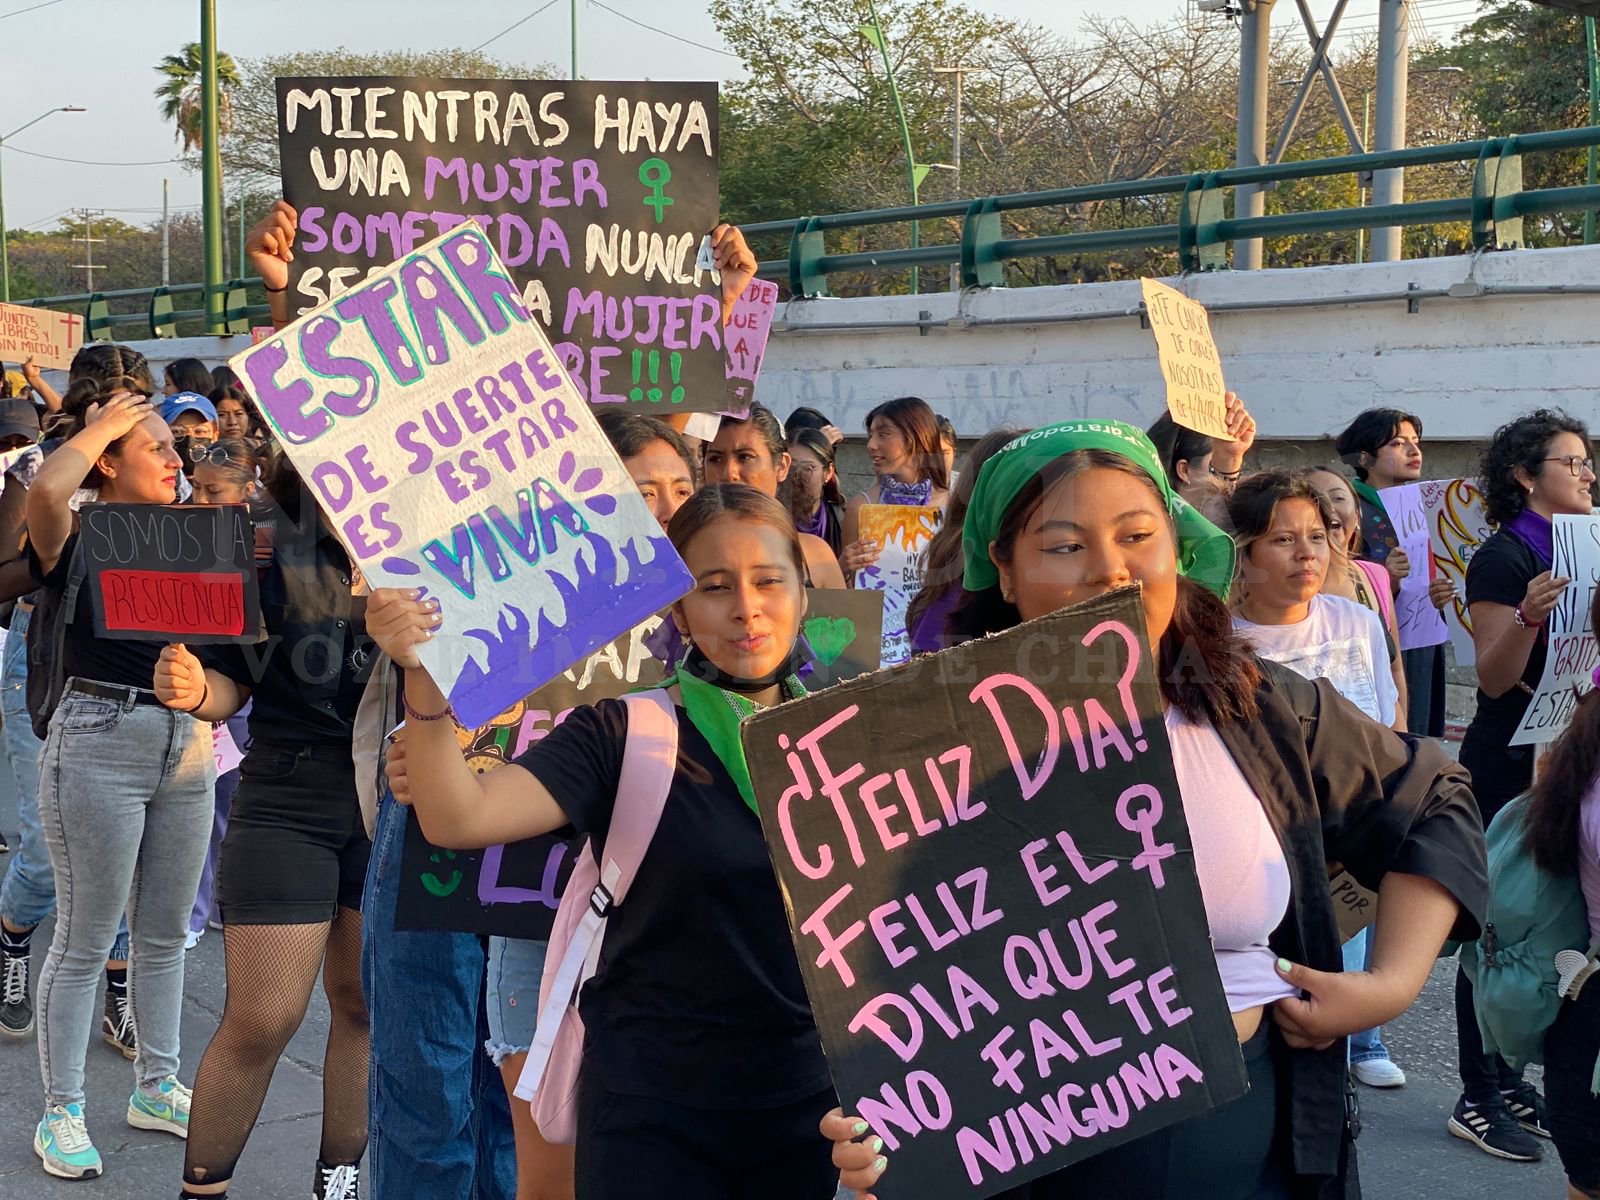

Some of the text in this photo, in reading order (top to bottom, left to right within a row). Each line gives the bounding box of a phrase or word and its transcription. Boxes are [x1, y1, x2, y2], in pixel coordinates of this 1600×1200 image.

[286, 87, 713, 157] MIENTRAS HAYA
[310, 146, 608, 208] UNA MUJER
[585, 223, 721, 288] NUNCA
[245, 229, 532, 445] ESTAR
[563, 287, 721, 351] MUJER
[1168, 360, 1220, 395] NOSOTRAS
[311, 349, 562, 513] DE SUERTE
[343, 398, 578, 559] ES ESTAR
[88, 510, 248, 563] SOMOS LA
[420, 477, 589, 600] VIVA
[1554, 521, 1578, 582] NI
[110, 572, 242, 627] RESISTENCIA
[800, 831, 1119, 988] FELIZ EL
[1331, 881, 1369, 915] POR
[848, 900, 1136, 1062] DIA QUE
[856, 1070, 953, 1151] NO
[955, 1043, 1203, 1185] NINGUNA
